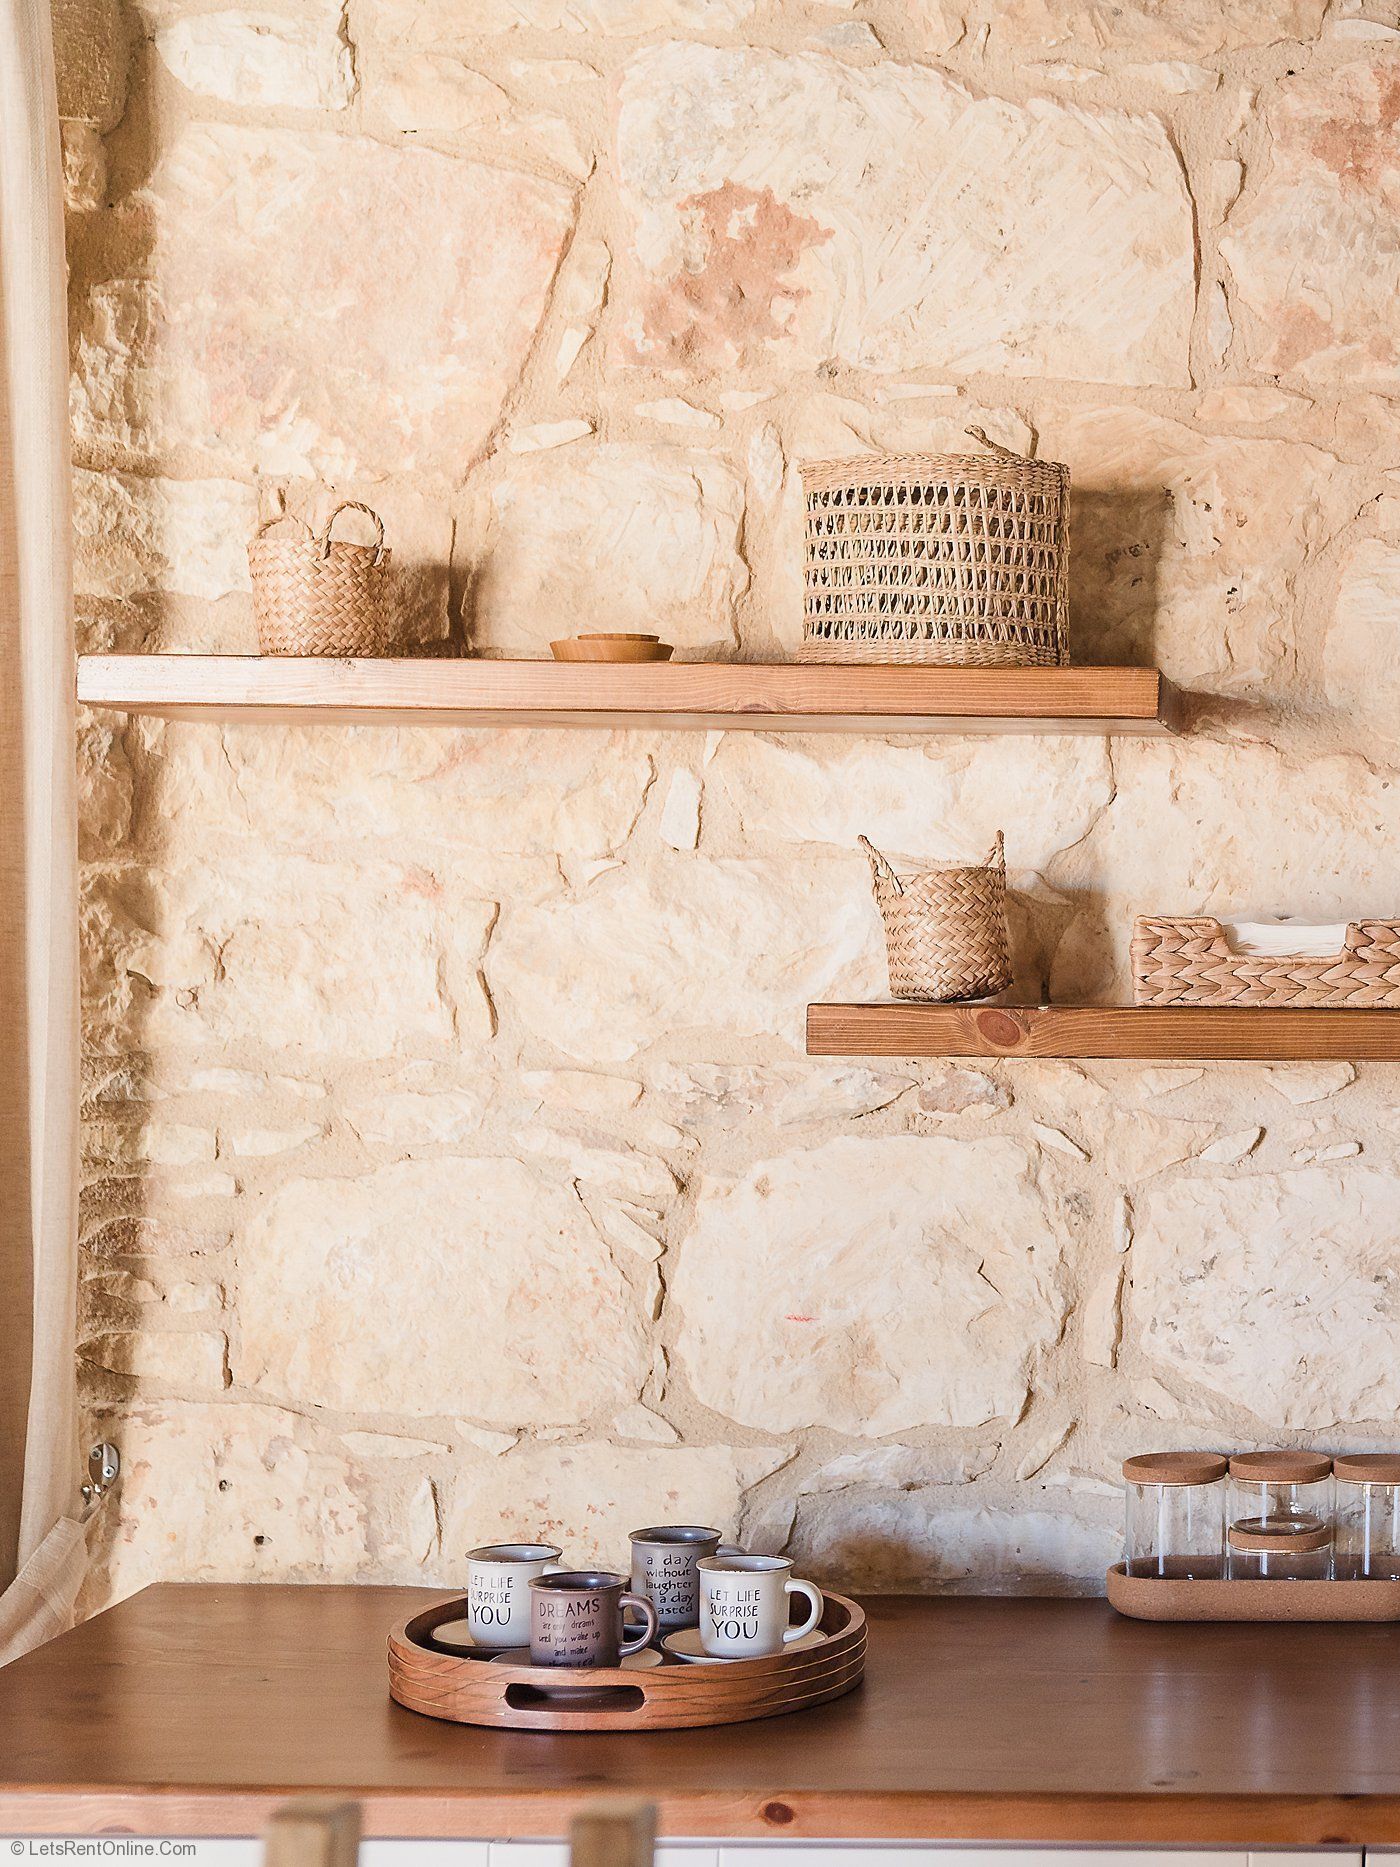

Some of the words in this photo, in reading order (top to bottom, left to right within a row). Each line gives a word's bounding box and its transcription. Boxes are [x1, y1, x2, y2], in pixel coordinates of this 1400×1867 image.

[646, 1556, 654, 1565] a
[663, 1554, 693, 1568] day
[646, 1567, 692, 1577] without
[470, 1574, 484, 1588] LET
[490, 1576, 514, 1589] LIFE
[645, 1579, 693, 1596] laughter
[470, 1587, 511, 1604] SURPRISE
[659, 1595, 667, 1604] a
[670, 1591, 695, 1606] day
[710, 1588, 728, 1601] LET
[737, 1589, 761, 1602] LIFE
[471, 1603, 511, 1626] YOU
[539, 1598, 600, 1618] DREAMS
[657, 1603, 693, 1615] asted
[710, 1602, 759, 1618] SURPRISE
[570, 1619, 595, 1629] dreams
[711, 1618, 759, 1640] YOU
